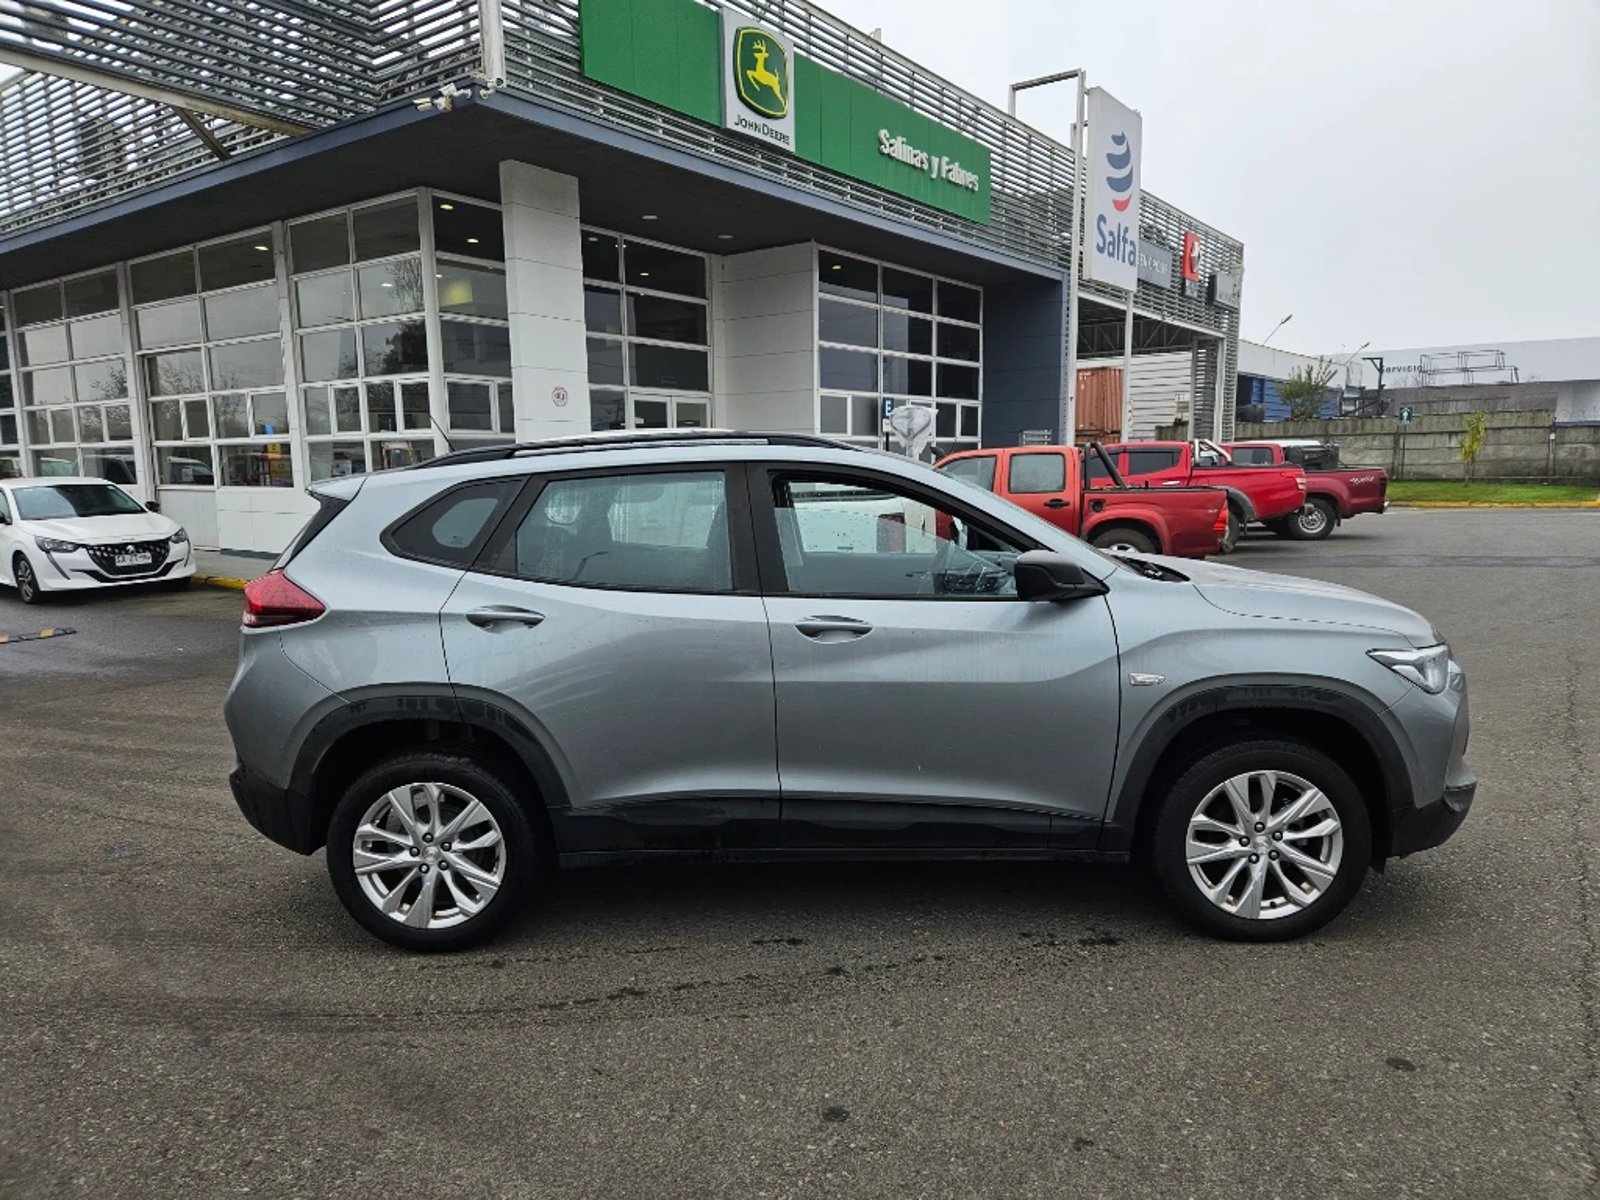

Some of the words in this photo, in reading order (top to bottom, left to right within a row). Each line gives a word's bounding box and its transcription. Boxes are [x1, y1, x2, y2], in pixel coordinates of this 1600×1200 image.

[734, 114, 761, 133] JOHN
[762, 123, 790, 146] DEERE
[878, 129, 928, 171] Salinas
[930, 155, 940, 179] y
[1096, 213, 1137, 268] Salfa
